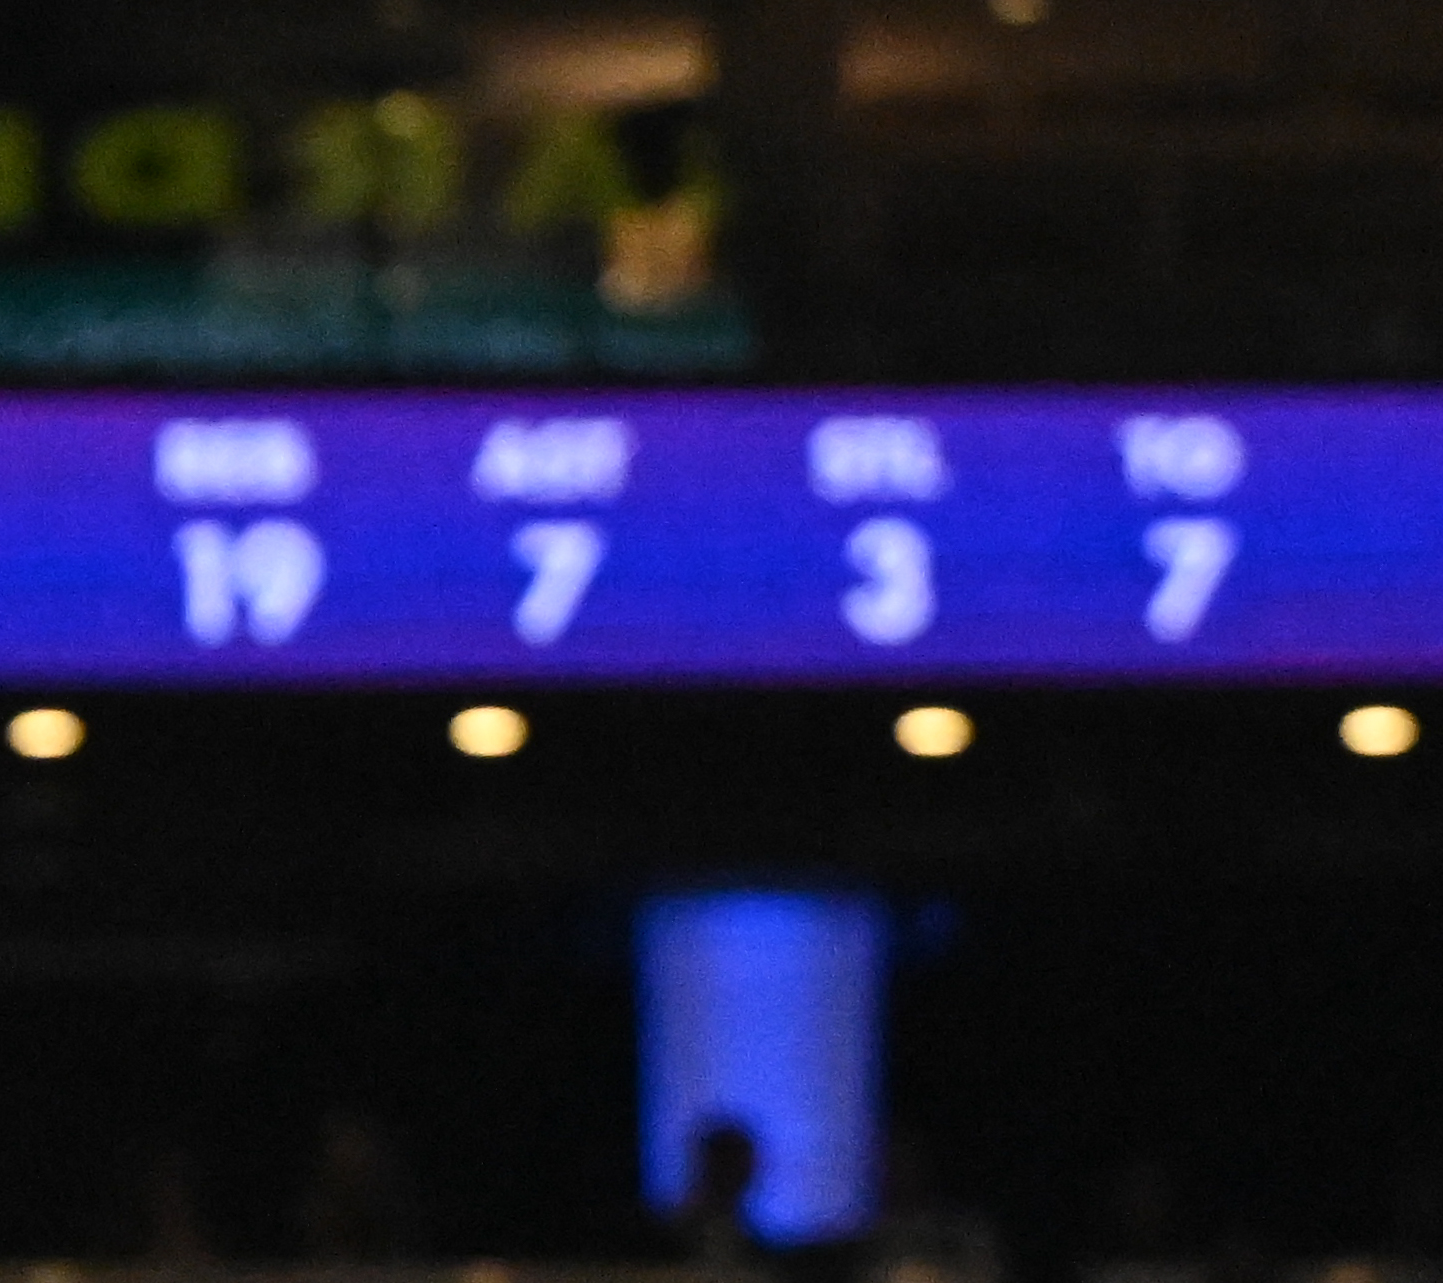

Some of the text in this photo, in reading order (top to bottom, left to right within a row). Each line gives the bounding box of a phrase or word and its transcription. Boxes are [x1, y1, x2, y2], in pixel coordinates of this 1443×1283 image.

[1117, 414, 1248, 501] TO
[174, 516, 1237, 647] 19 7 3 7
